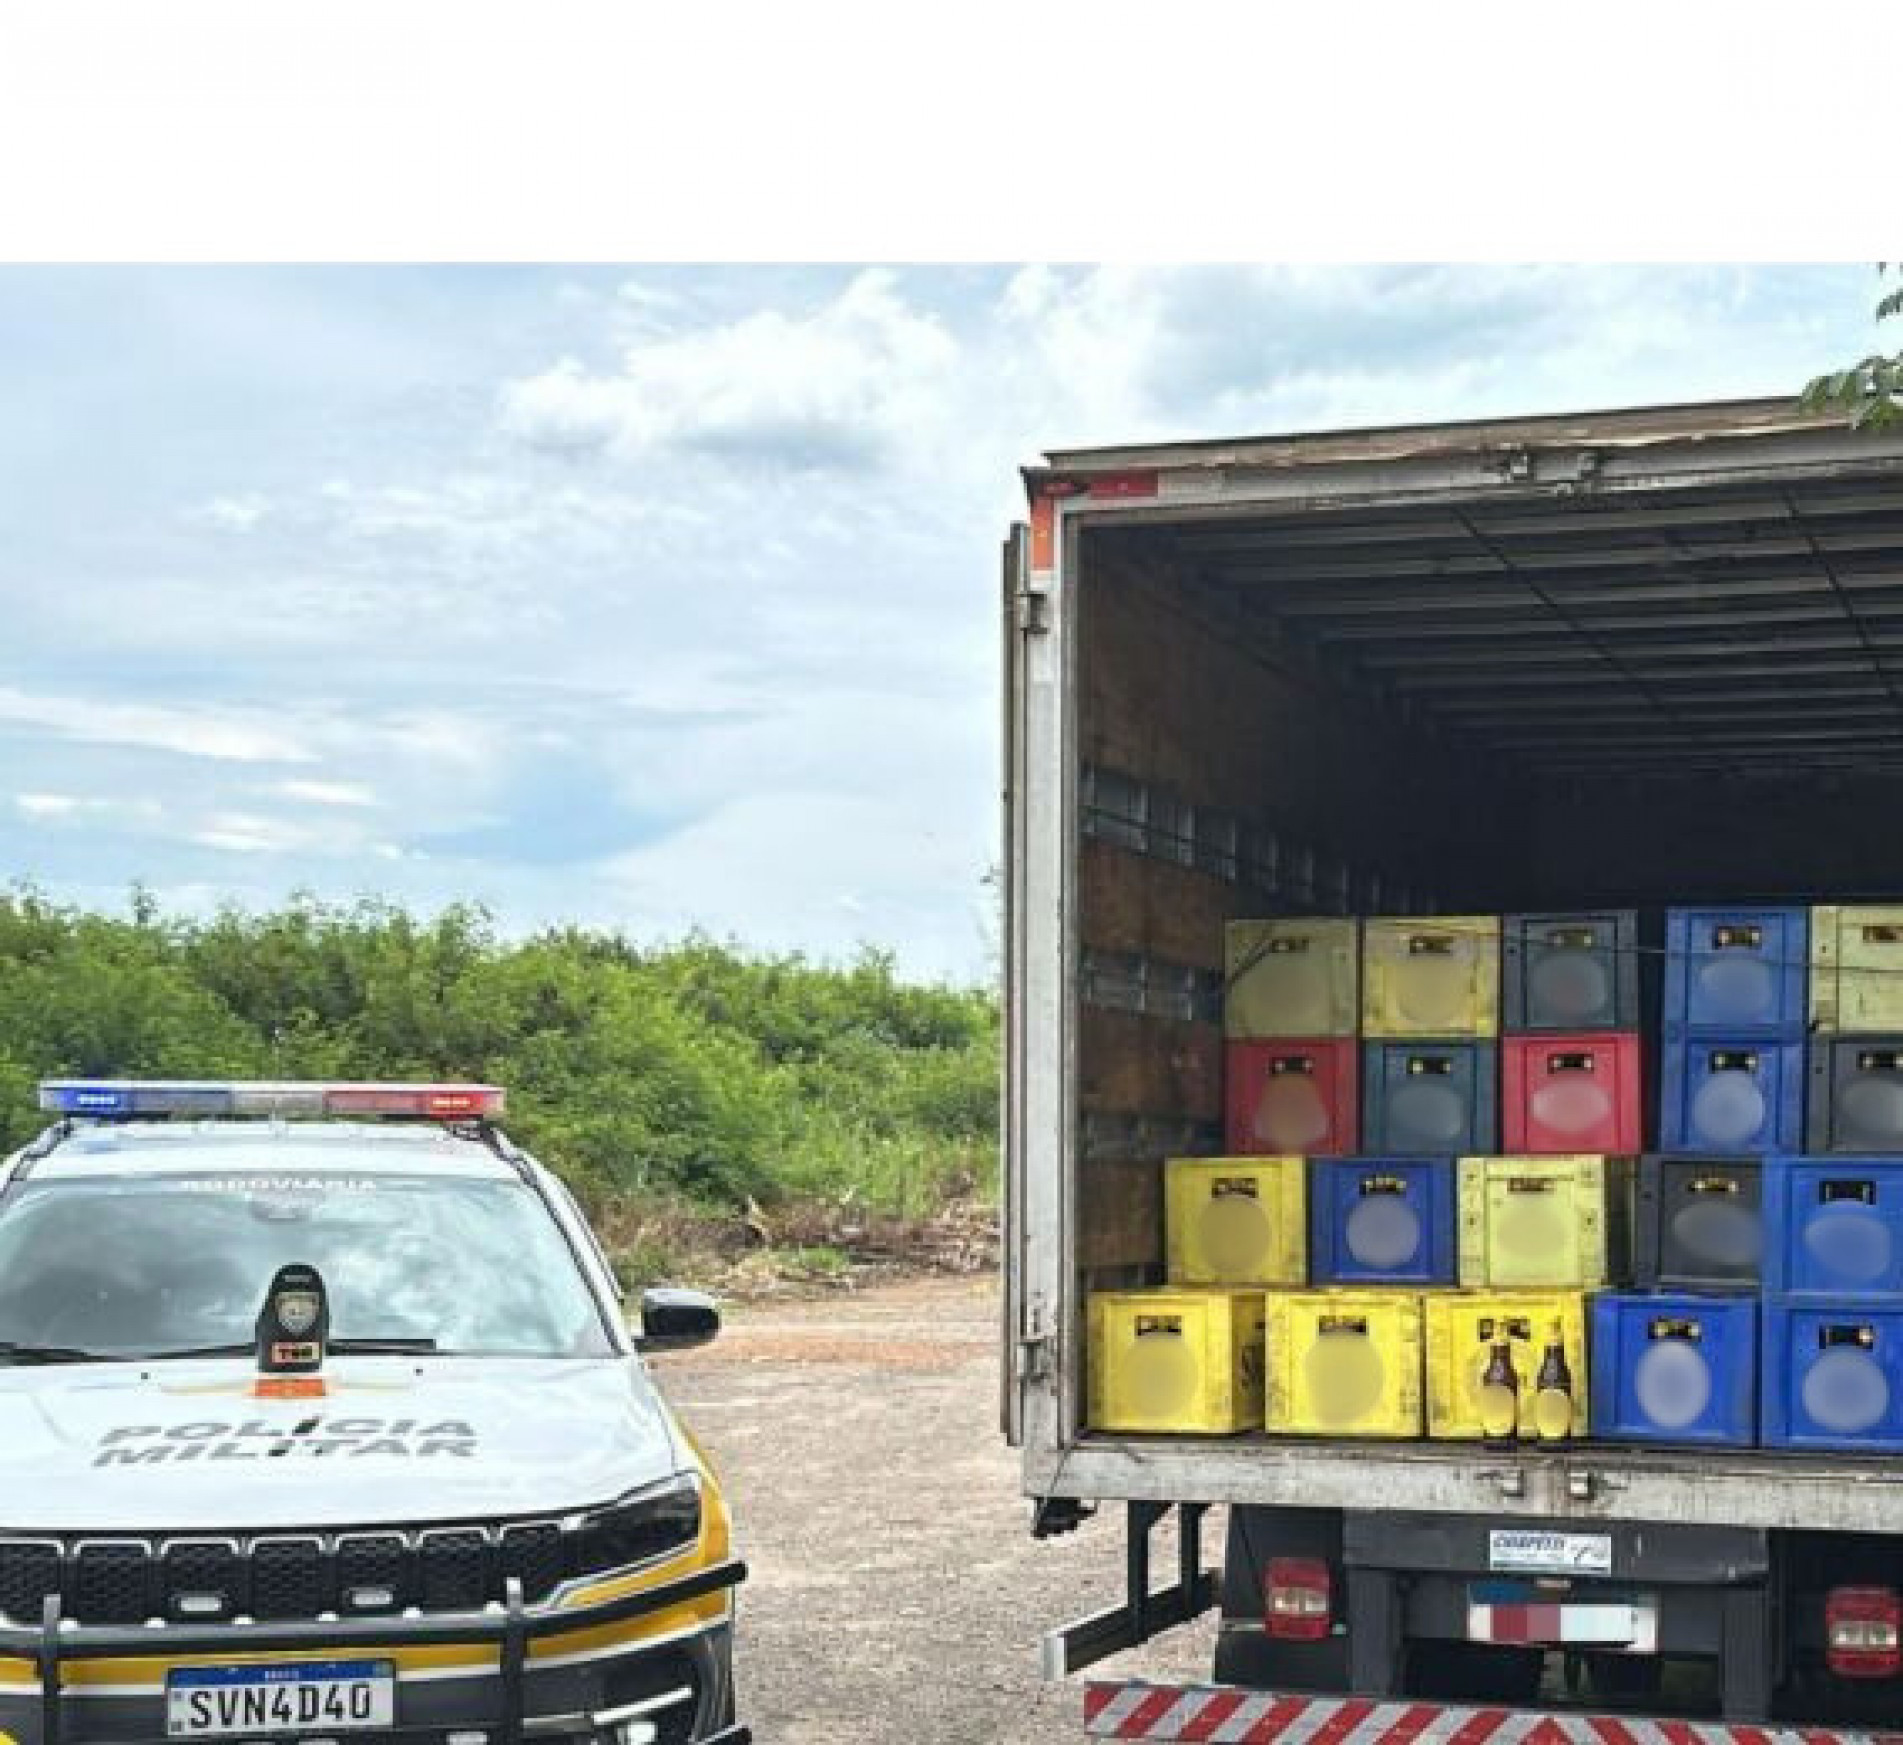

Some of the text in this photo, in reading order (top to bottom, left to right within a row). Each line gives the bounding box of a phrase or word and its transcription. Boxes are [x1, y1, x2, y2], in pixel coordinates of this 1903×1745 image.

[98, 1414, 478, 1446] POLÍCIA
[92, 1438, 480, 1467] MILITAR
[189, 1684, 371, 1728] SVN4D40
